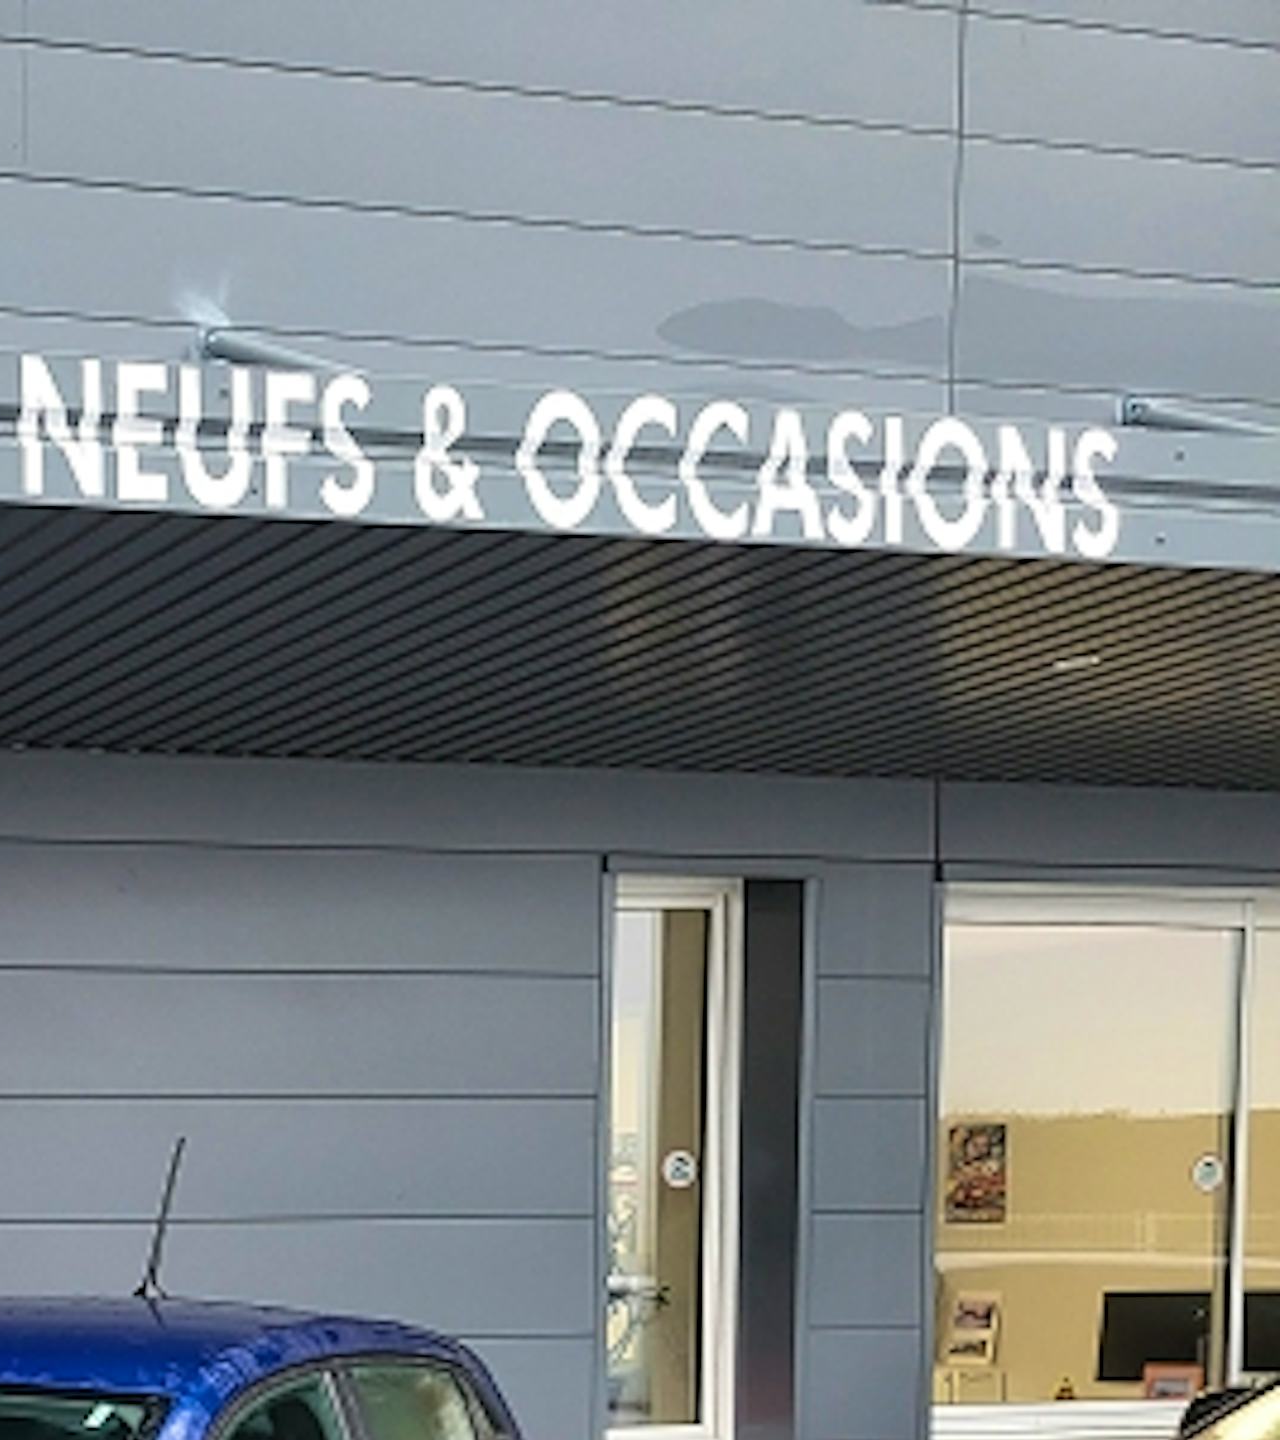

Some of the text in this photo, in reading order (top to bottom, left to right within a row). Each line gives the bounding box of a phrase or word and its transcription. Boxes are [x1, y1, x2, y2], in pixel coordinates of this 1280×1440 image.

[19, 351, 374, 519] NEUFS
[411, 385, 484, 523] &
[516, 388, 1120, 560] OCCASIONS
